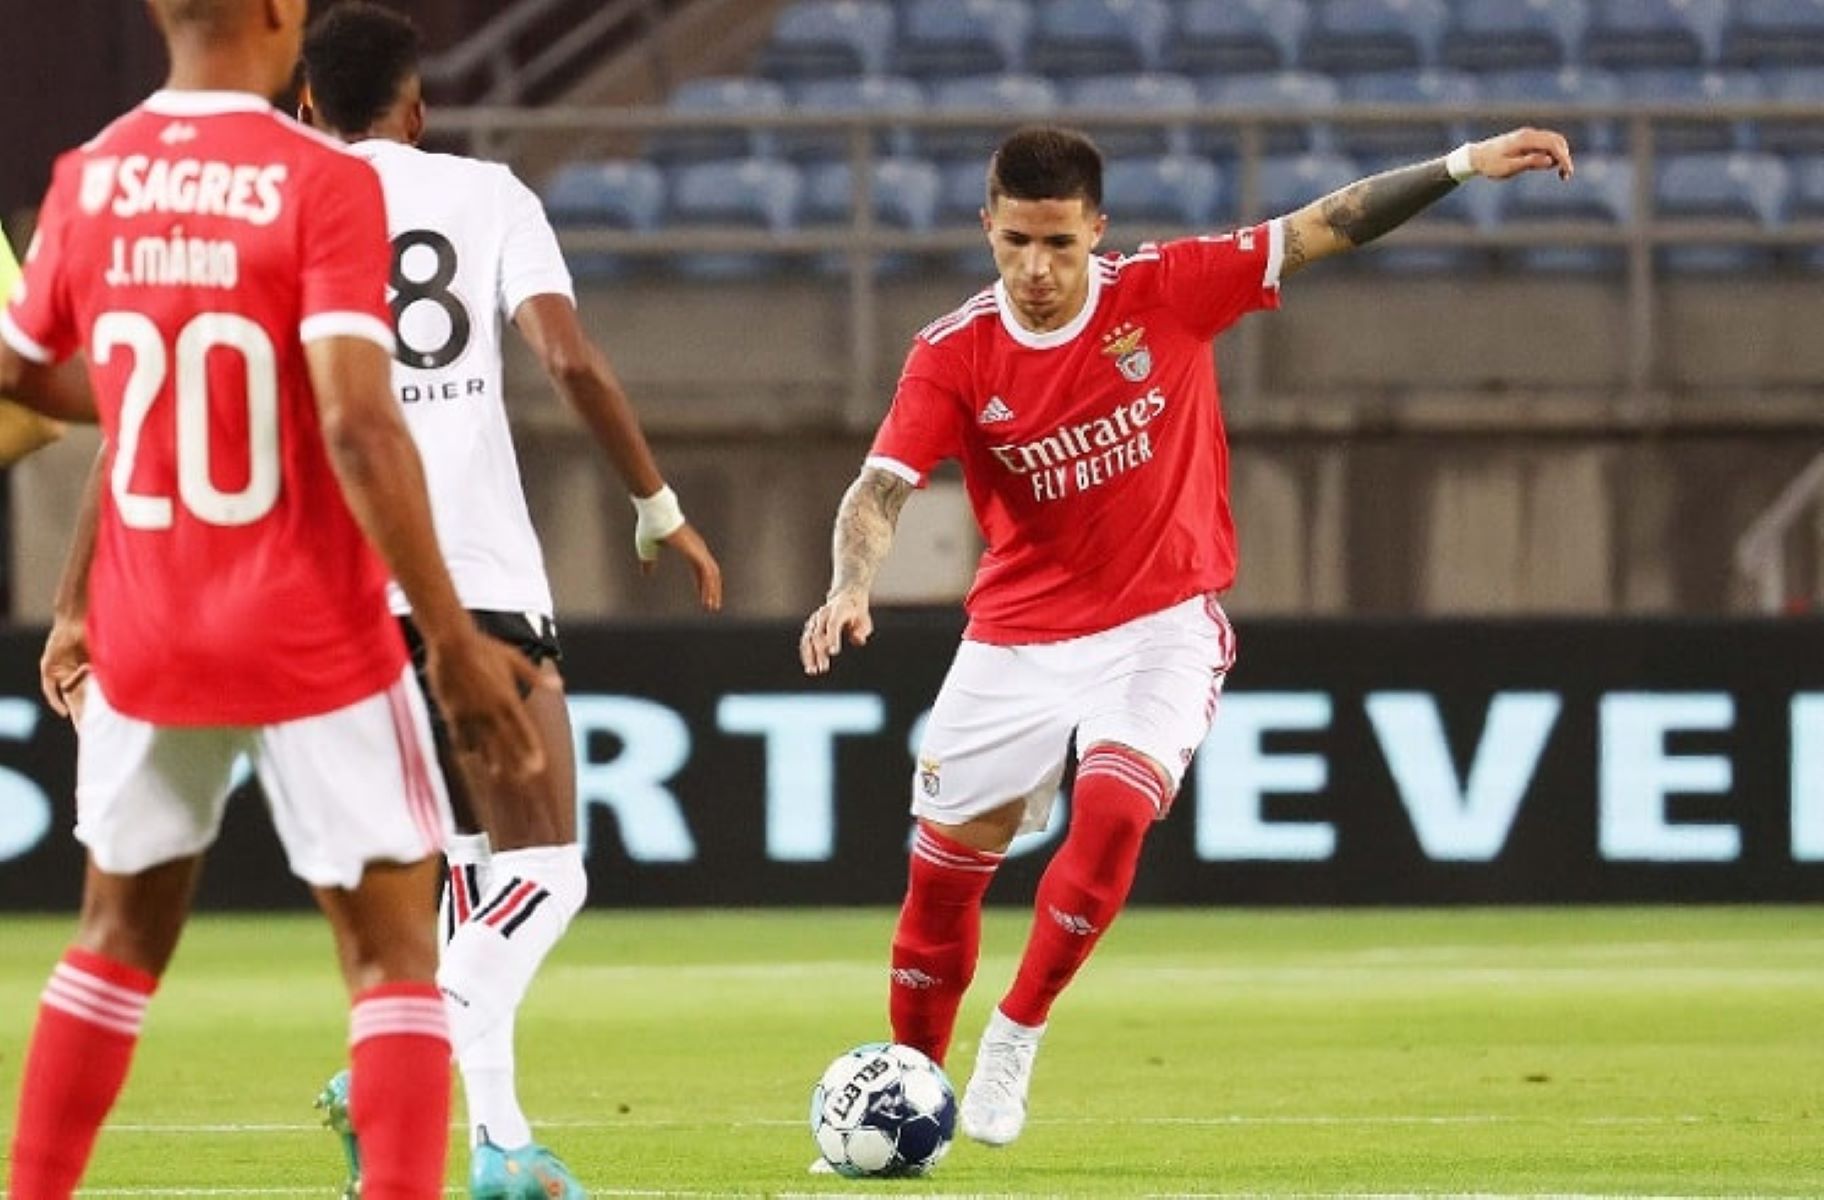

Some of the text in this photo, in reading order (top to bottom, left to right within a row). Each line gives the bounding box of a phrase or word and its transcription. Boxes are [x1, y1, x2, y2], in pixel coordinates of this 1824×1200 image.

[113, 154, 288, 226] SAGRES
[91, 310, 281, 531] 20
[988, 387, 1166, 473] Emirates
[1031, 431, 1152, 502] FLY BETTER
[1197, 691, 1824, 861] EVE
[832, 1057, 889, 1121] SELECT
